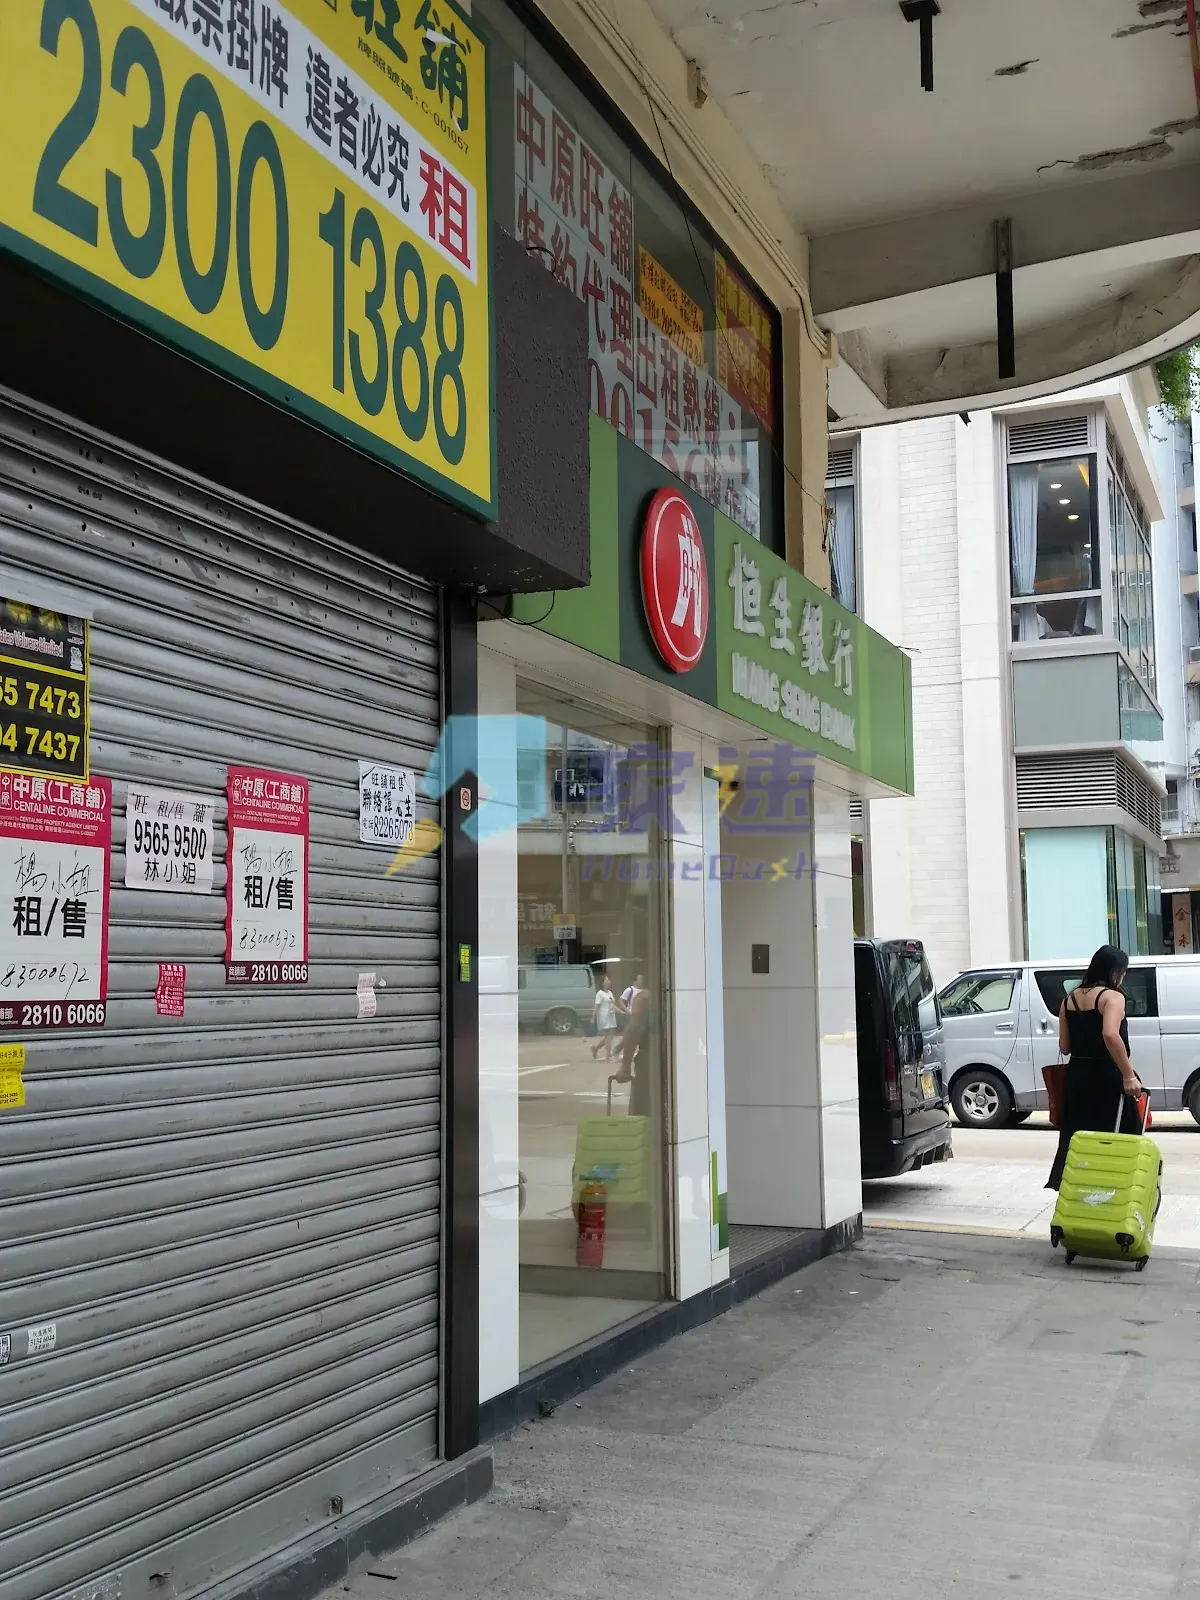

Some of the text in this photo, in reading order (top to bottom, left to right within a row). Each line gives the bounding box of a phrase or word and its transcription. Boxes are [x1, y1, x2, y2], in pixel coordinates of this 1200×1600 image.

[304, 43, 410, 212] 違者必究
[419, 148, 470, 270] 租
[516, 83, 634, 280] 中原旺舖
[32, 0, 290, 351] 2300
[318, 187, 468, 466] 1388
[38, 636, 64, 659] Limited
[0, 675, 80, 719] 5 7473
[731, 650, 857, 752] HANG SENG BANK
[0, 723, 80, 762] 4 7437
[241, 776, 305, 804] 中原(工商舖)
[242, 797, 305, 815] CENTALINE COMMERCIAL
[13, 799, 106, 823] CENTALINE COMMERCIAL
[157, 799, 184, 820] 租/售
[134, 818, 207, 861] 9565 9500
[144, 856, 197, 885] 林小姐
[243, 875, 294, 911] 租/售
[12, 895, 88, 939] 租/售
[240, 927, 296, 959] 83000672
[1, 962, 90, 1001] 83000672
[251, 964, 279, 982] 2810
[281, 964, 308, 982] 6066
[21, 1004, 62, 1026] 2810
[67, 1003, 105, 1024] 6066
